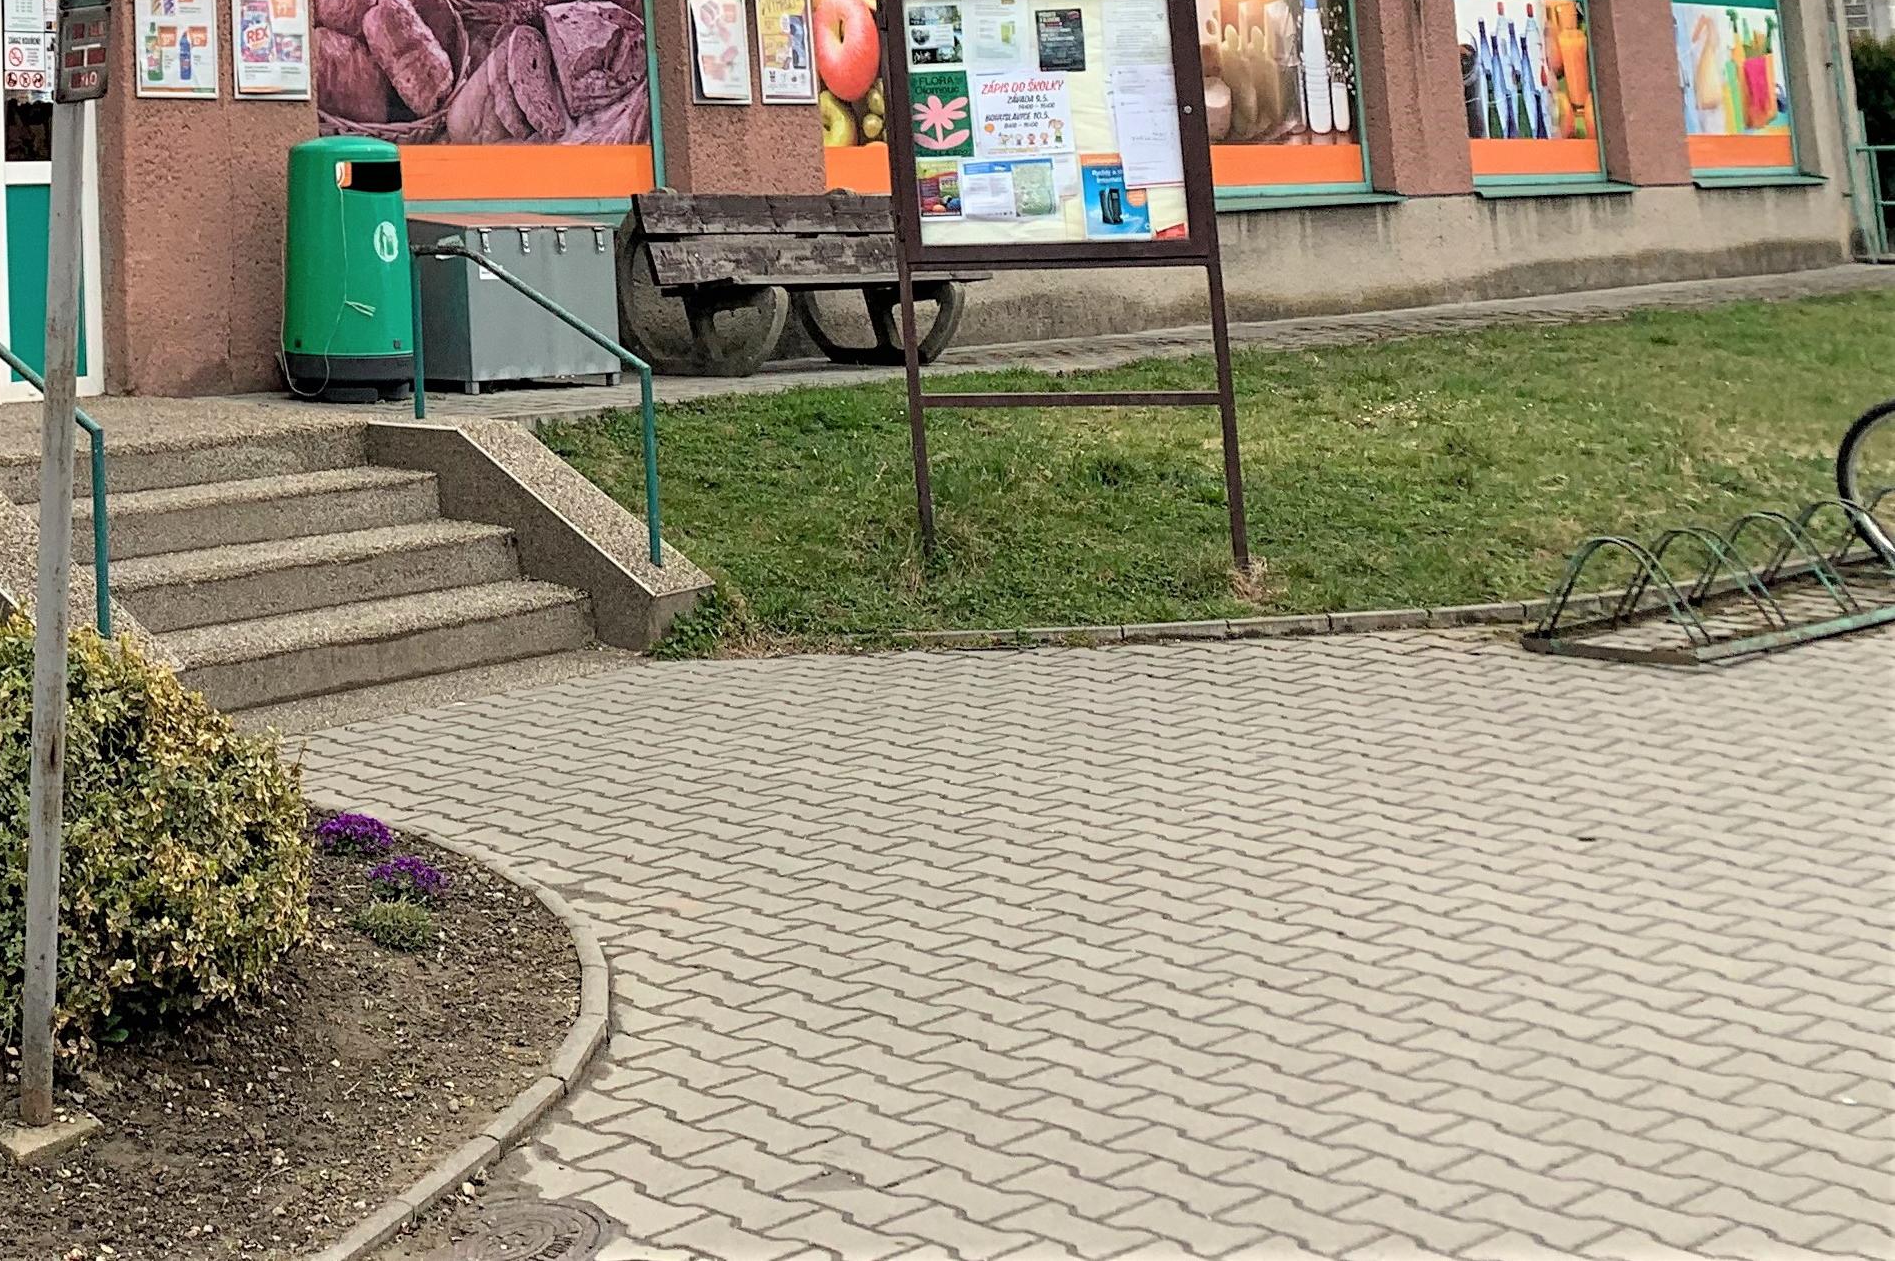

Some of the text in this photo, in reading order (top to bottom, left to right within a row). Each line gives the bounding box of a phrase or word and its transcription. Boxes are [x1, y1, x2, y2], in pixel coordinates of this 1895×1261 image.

[918, 76, 954, 86] FLORA
[982, 78, 1064, 94] ZÁPIS DO ŠKOLKY
[915, 85, 960, 95] Olomouc
